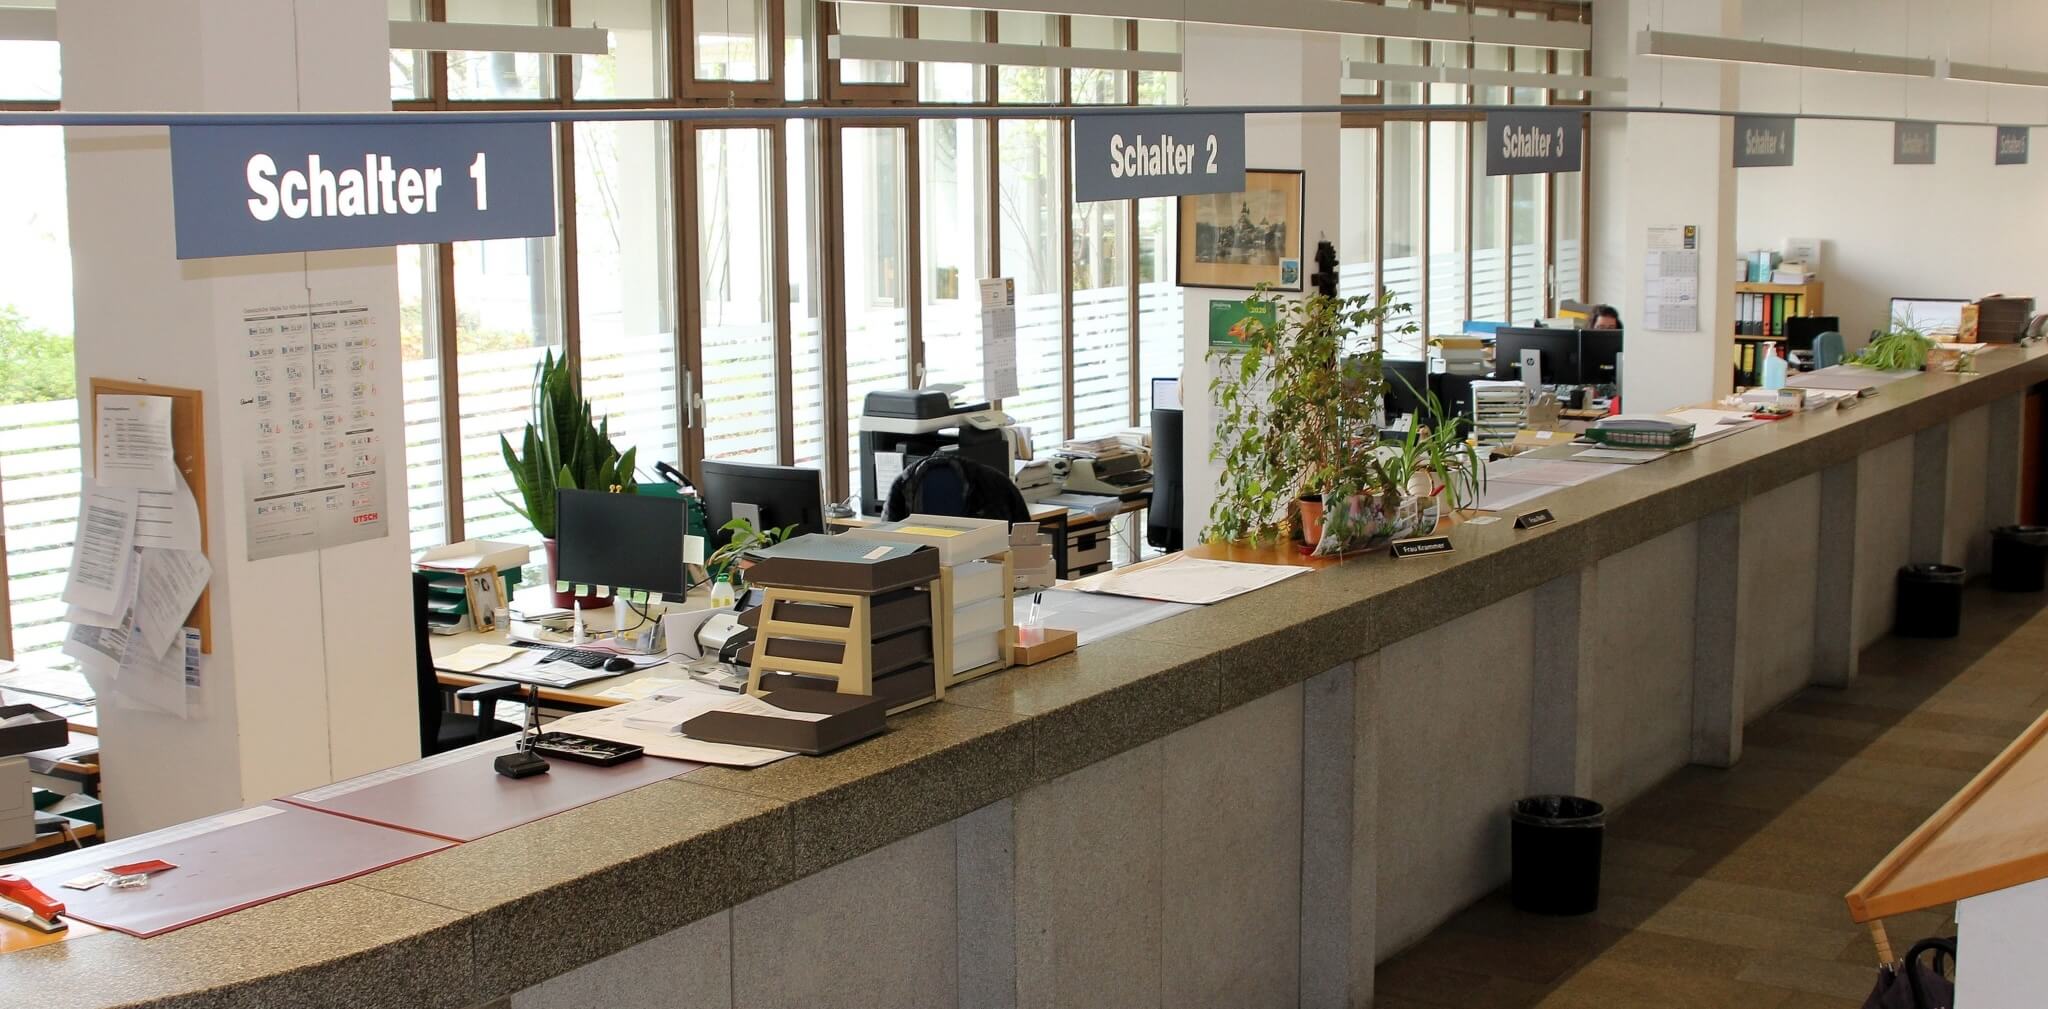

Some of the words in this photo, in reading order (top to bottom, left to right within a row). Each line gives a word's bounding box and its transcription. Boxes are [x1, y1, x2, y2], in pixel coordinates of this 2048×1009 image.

[1110, 134, 1195, 178] Schalter
[1206, 134, 1218, 174] 2
[1503, 125, 1551, 158] Schalter
[1556, 127, 1564, 157] 3
[1745, 127, 1777, 155] Schalter
[1779, 128, 1785, 155] 4
[246, 153, 443, 222] Schalter
[469, 152, 487, 211] 1
[353, 512, 378, 523] UTSCH
